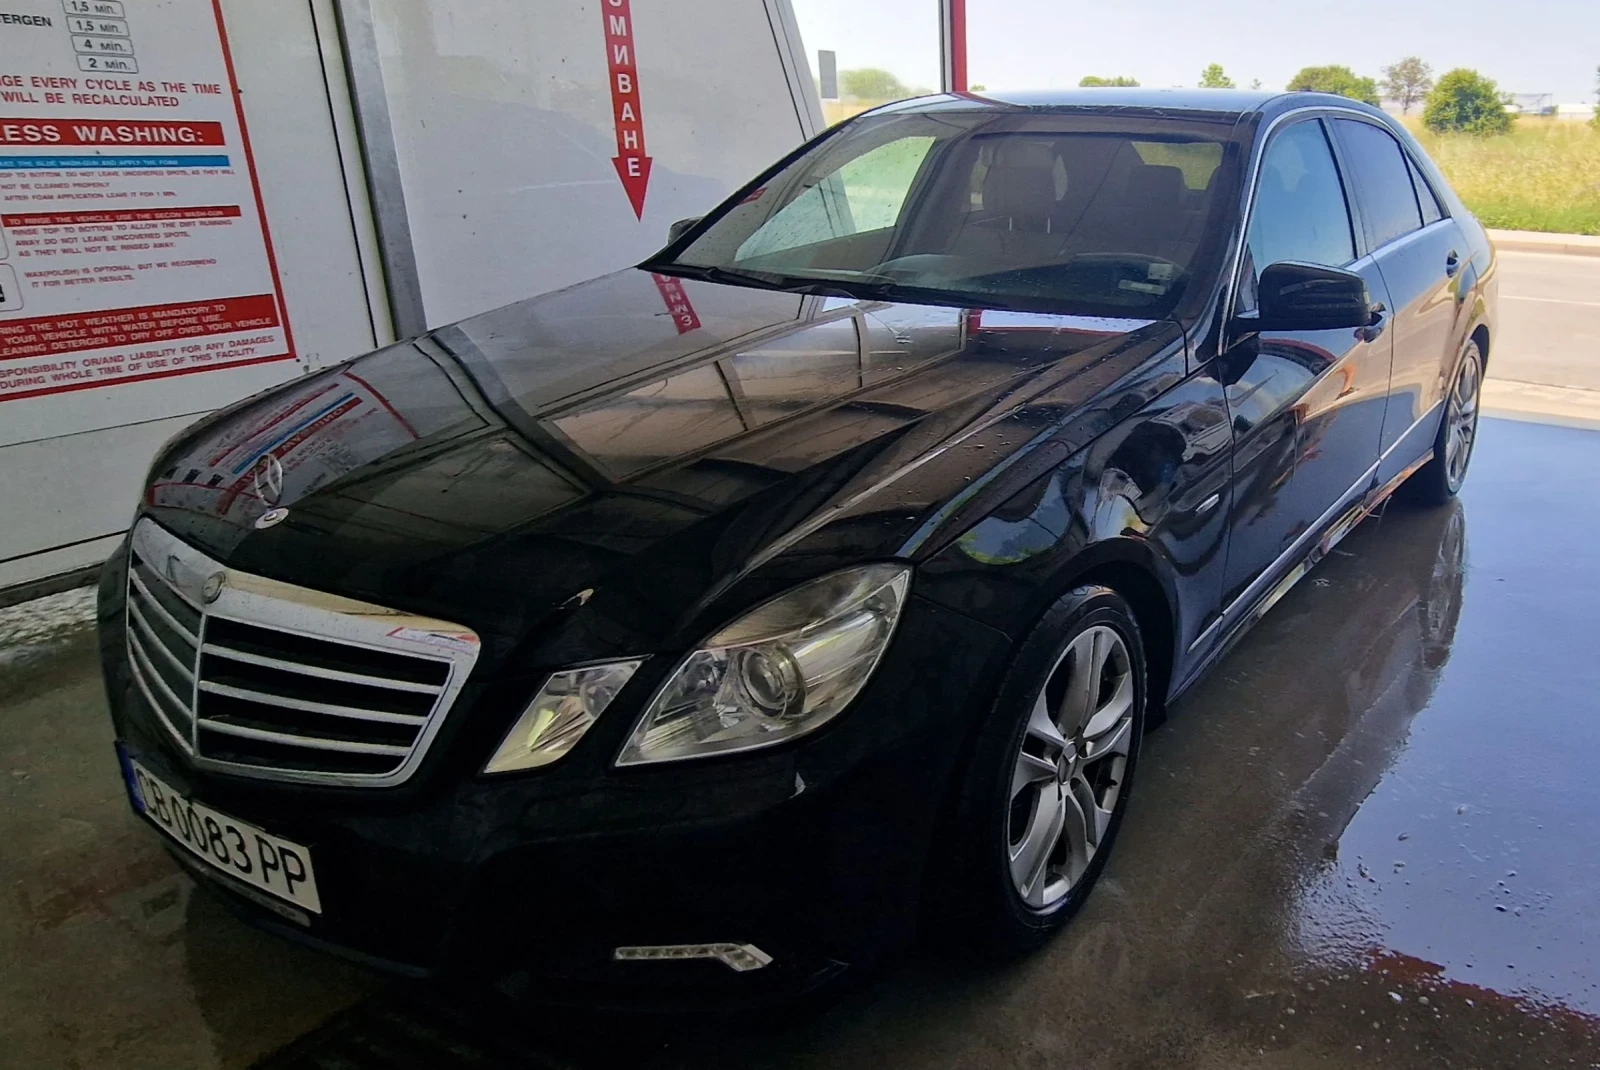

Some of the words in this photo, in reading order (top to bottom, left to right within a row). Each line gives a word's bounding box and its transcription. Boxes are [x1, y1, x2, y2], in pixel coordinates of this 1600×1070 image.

[71, 0, 89, 13] 1,5
[76, 20, 94, 33] 1,5
[84, 39, 93, 49] 4
[88, 58, 98, 68] 2
[0, 75, 24, 87] GE
[31, 76, 78, 89] EVERY
[85, 78, 132, 91] CYCLE
[138, 81, 156, 92] AS
[161, 82, 187, 93] THE
[192, 83, 222, 94] TIME
[0, 91, 39, 103] WILL
[44, 92, 65, 104] BE
[72, 93, 179, 107] RECALCULATED
[0, 124, 61, 142] ESS
[72, 125, 204, 143] WASHING:
[112, 233, 161, 241] UNCOVERED
[171, 258, 217, 267] RECOMMEND
[63, 277, 96, 285] BETTER
[28, 322, 53, 332] THE
[56, 319, 79, 329] HOT
[84, 313, 135, 326] WEATHER
[138, 312, 149, 320] IS
[152, 306, 210, 319] MANDATORY
[213, 304, 226, 312] TO
[0, 343, 47, 356] EANING
[51, 336, 109, 350] DETERGEN
[113, 334, 126, 342] TO
[130, 331, 150, 340] DRY
[154, 328, 174, 338] OFF
[178, 325, 204, 335] OVER
[207, 321, 233, 332] YOUR
[235, 317, 273, 328] VEHICLE
[4, 334, 37, 345] YOUR
[41, 329, 88, 341] VEHICLE
[91, 325, 118, 335] WITH
[121, 321, 157, 332] WATER
[160, 317, 198, 328] BEFORE
[0, 360, 77, 378] SPONSIBILITY
[129, 348, 177, 361] LIABILITY
[180, 344, 202, 354] FOR
[205, 341, 225, 351] ANY
[228, 335, 275, 348] DAMAGES
[0, 375, 46, 389] DURING
[51, 369, 93, 382] WHOLE
[97, 365, 123, 375] TIME
[128, 362, 142, 371] OF
[146, 359, 168, 369] USE
[172, 356, 186, 365] OF
[189, 353, 213, 362] THIS
